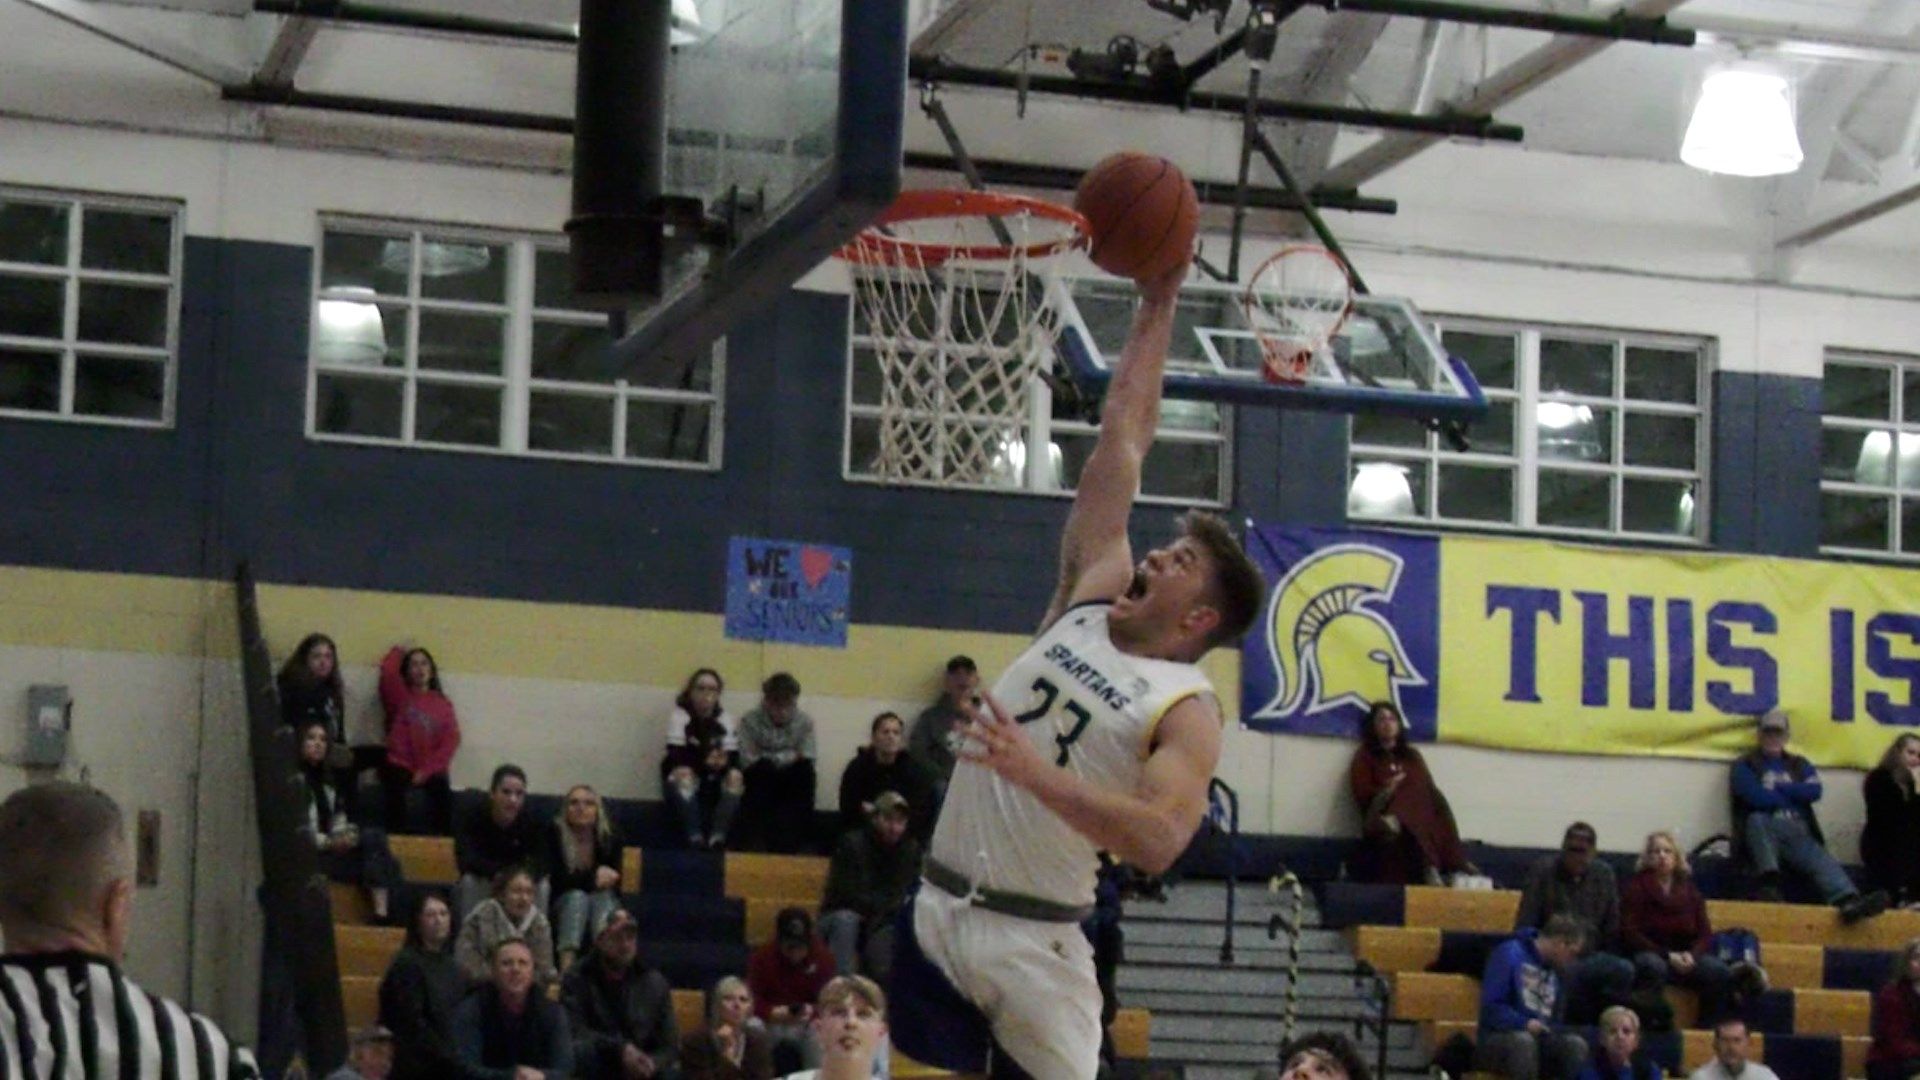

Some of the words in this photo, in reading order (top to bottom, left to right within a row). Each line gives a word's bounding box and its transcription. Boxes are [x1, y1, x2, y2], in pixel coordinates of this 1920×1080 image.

[745, 547, 791, 578] WE
[1044, 643, 1132, 711] SPARTANS
[1486, 584, 1778, 716] THIS
[1830, 607, 1920, 726] IS
